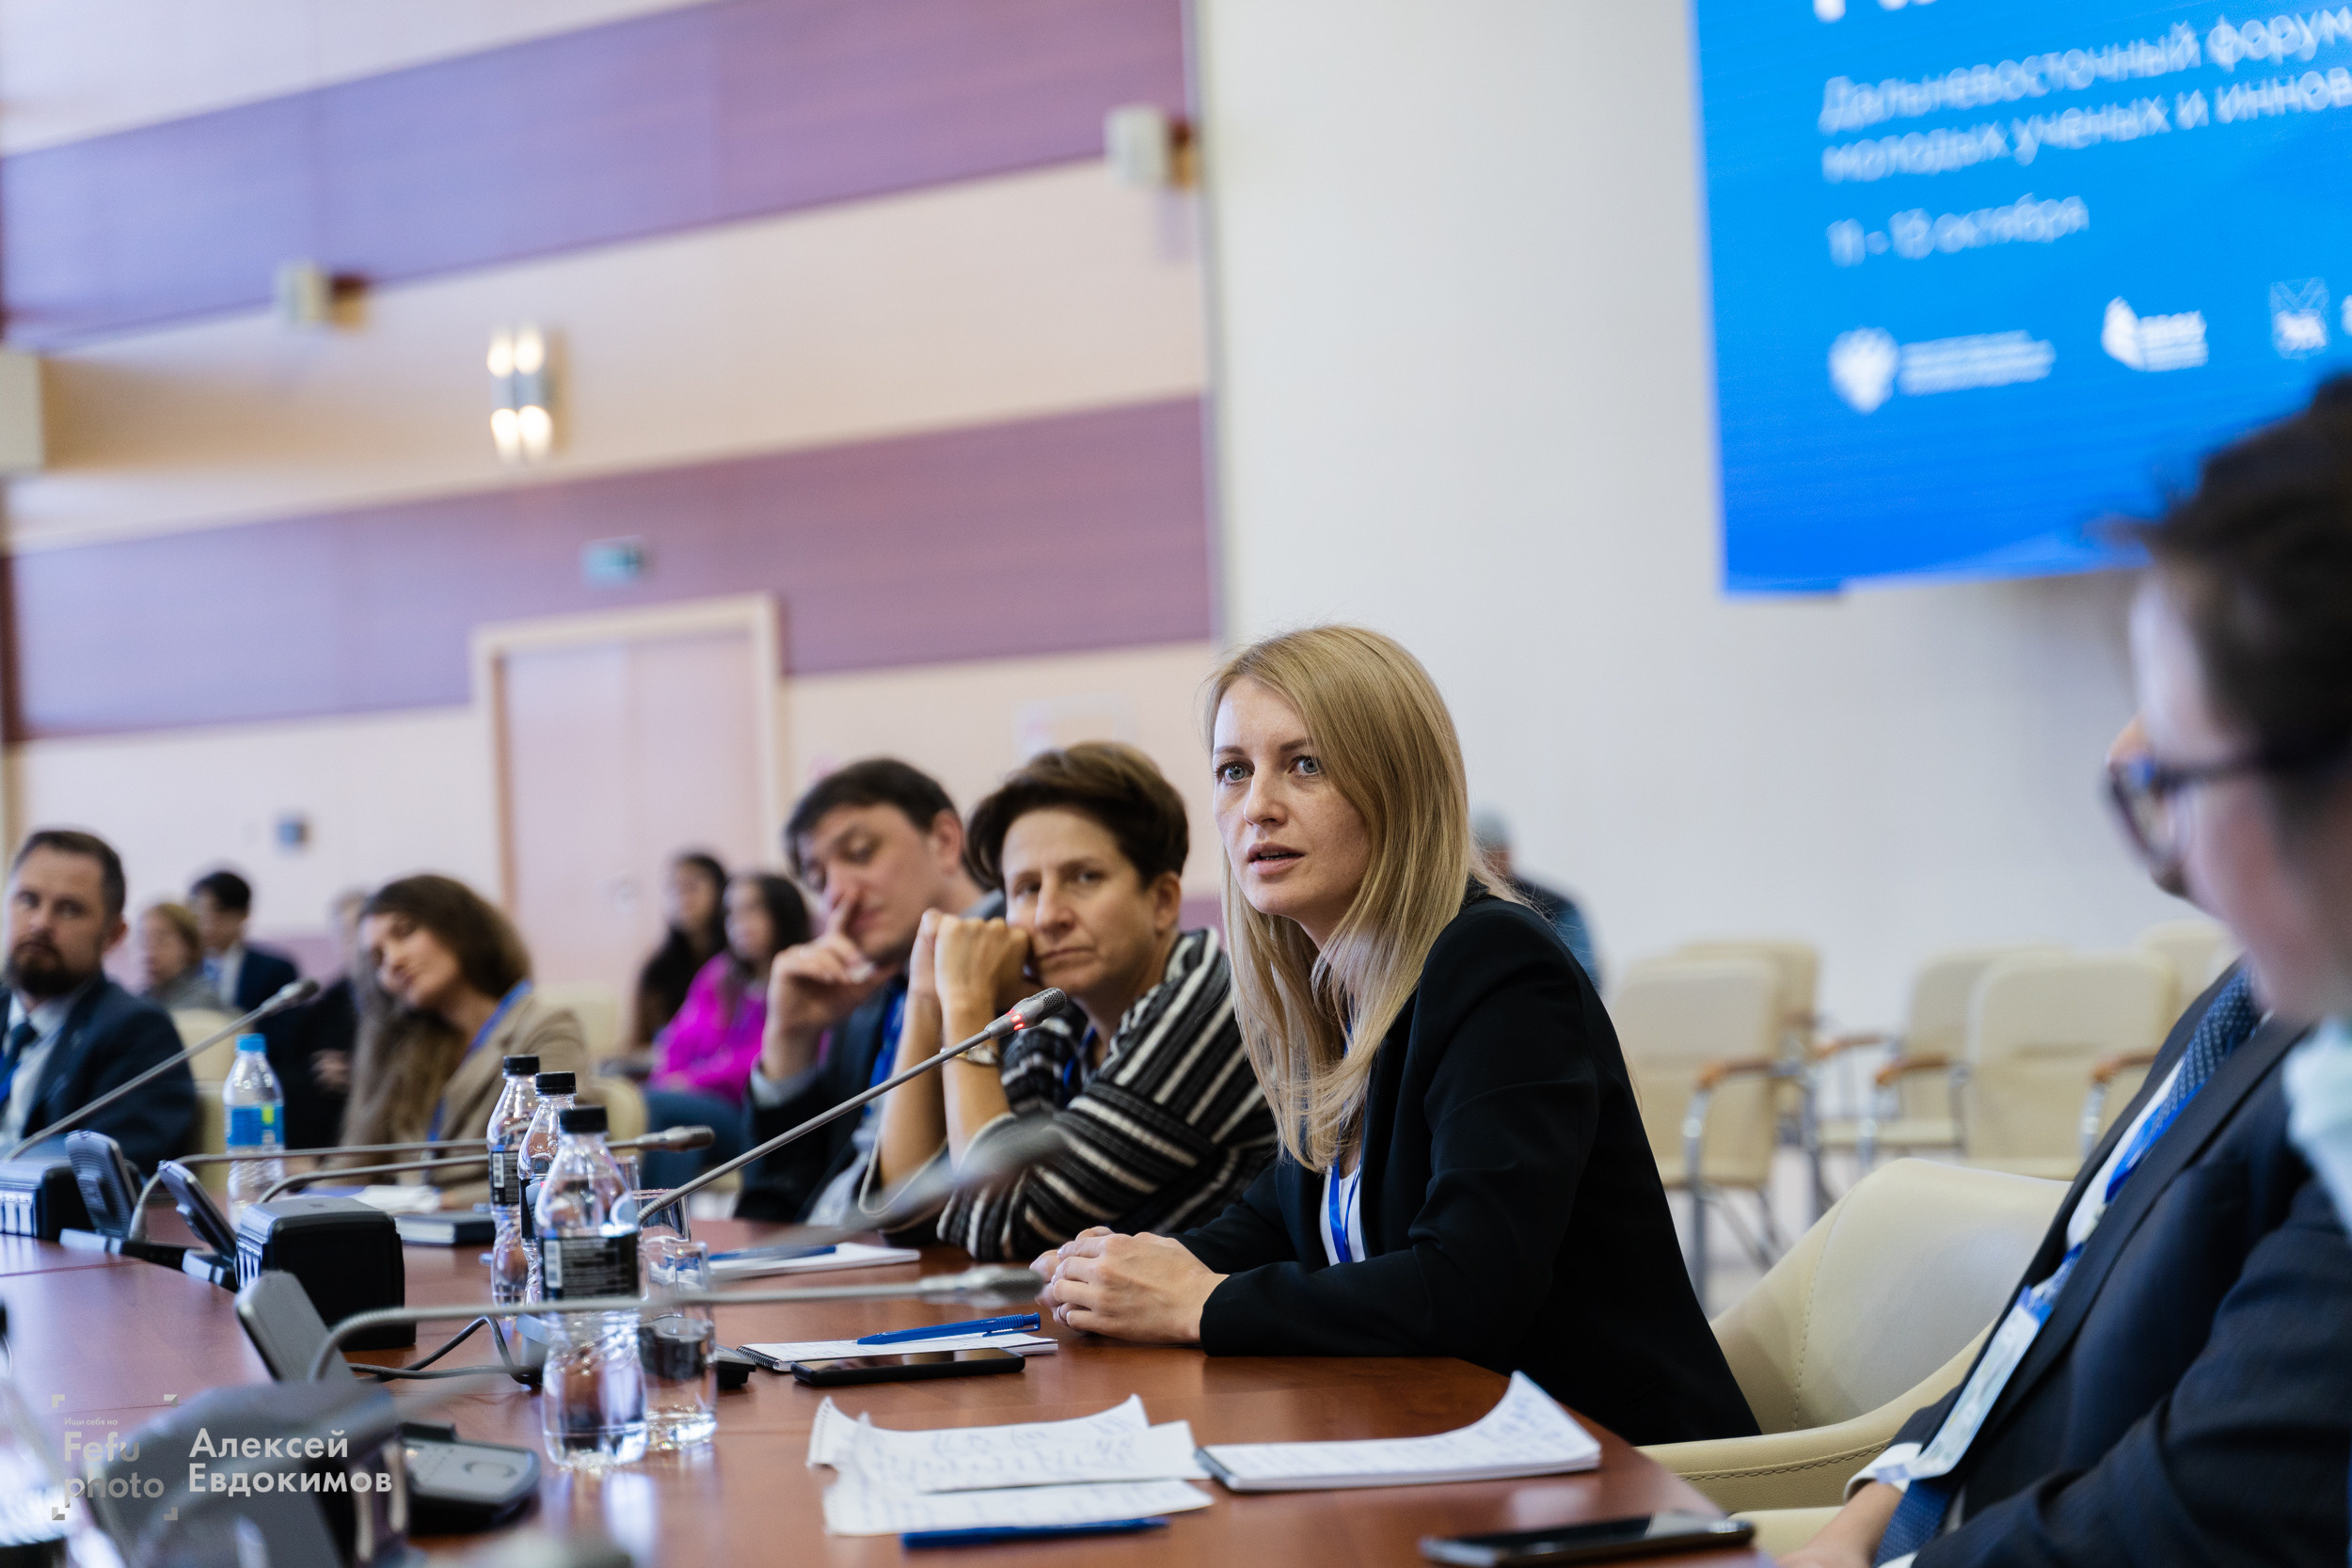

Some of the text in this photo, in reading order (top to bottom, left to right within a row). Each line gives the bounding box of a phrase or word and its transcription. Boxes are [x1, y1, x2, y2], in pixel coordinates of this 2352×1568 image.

[1821, 120, 2010, 184] молодых
[2175, 88, 2210, 130] и
[1933, 192, 2090, 253] октября
